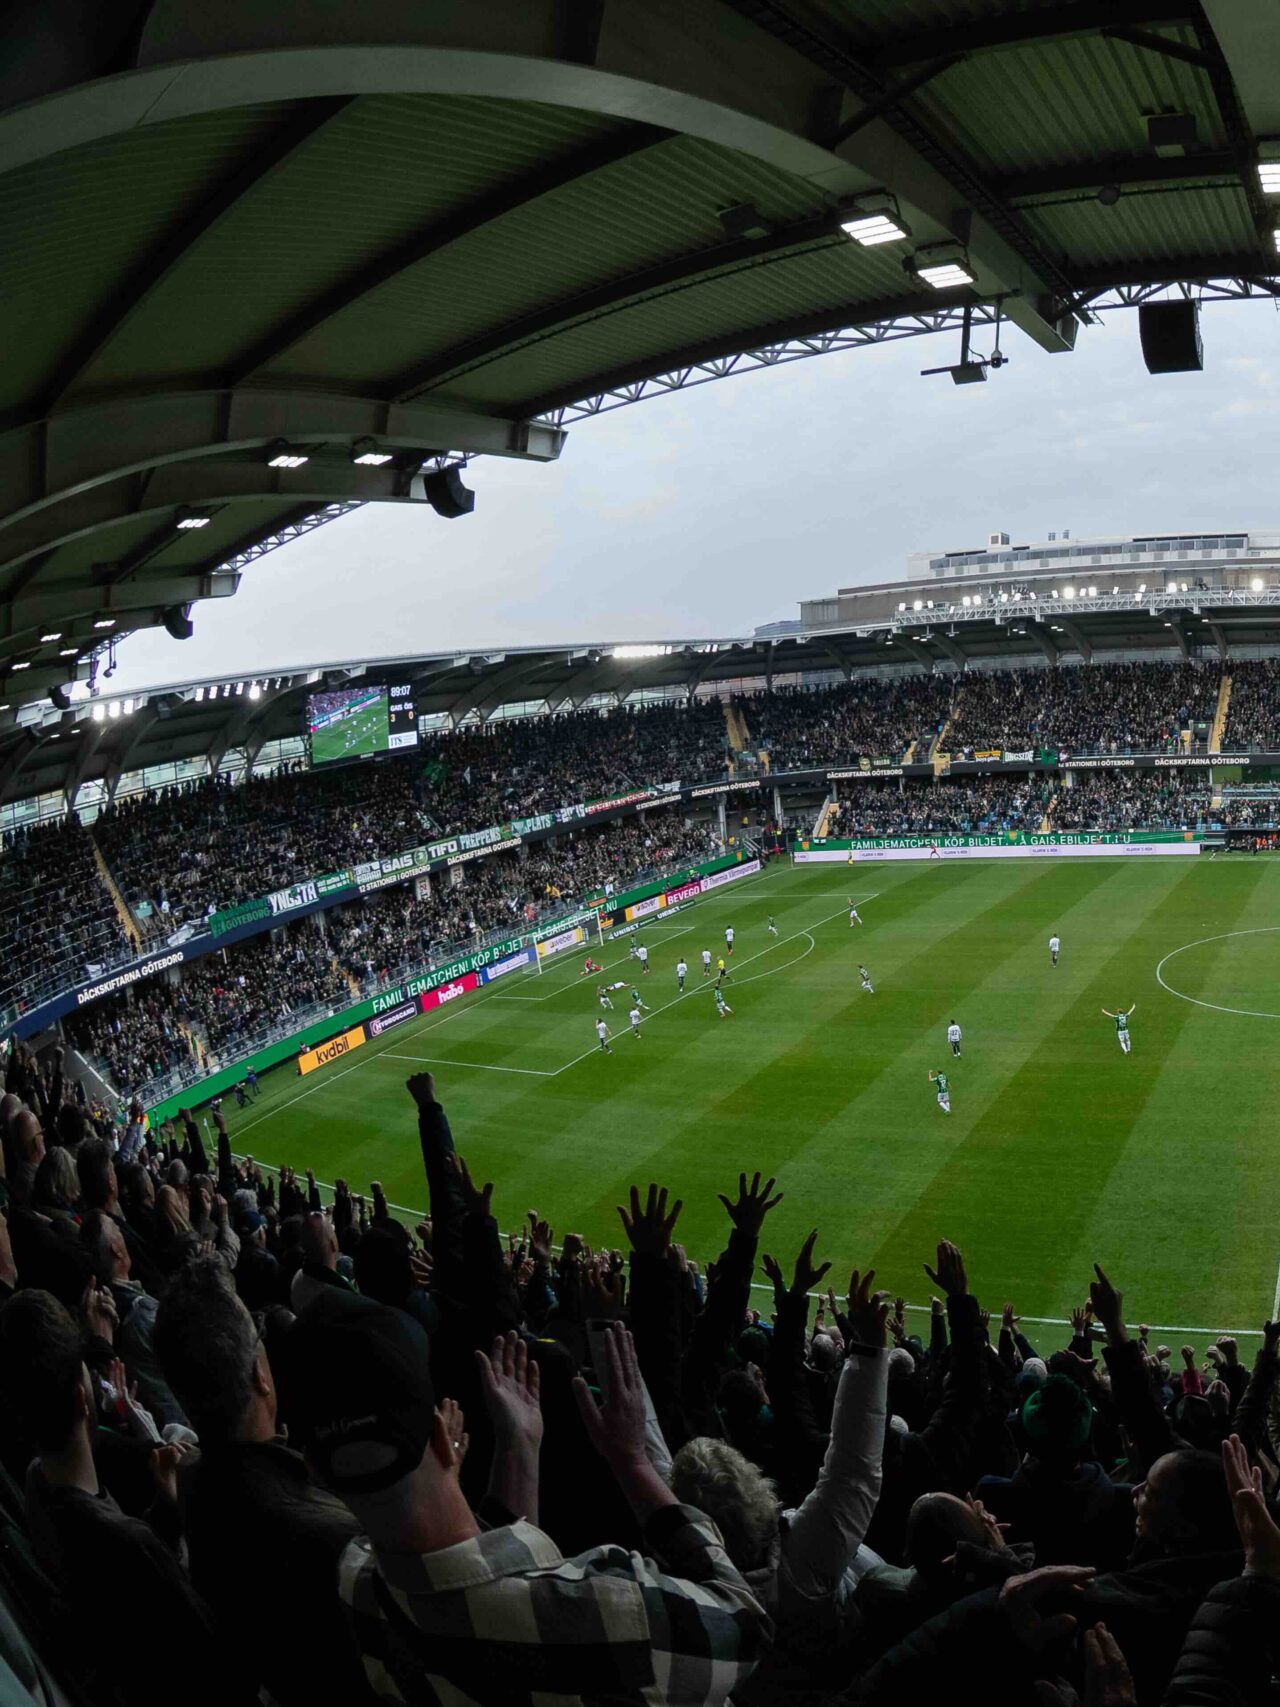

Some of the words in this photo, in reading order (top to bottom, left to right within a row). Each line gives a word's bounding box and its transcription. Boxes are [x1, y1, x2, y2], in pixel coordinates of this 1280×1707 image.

[391, 685, 411, 697] 89:07
[390, 713, 396, 722] 3
[408, 711, 414, 720] 0
[1155, 758, 1210, 766] DÄCKSKIFTARNA
[1211, 757, 1250, 765] GÖTEBORG
[827, 771, 871, 779] DÄCKSKIFTARNA
[730, 780, 760, 790] GÖTEBORG
[851, 838, 941, 850] FAMILJEMATCHEN!
[944, 836, 965, 847] KÖP
[969, 836, 1007, 846] BILJET
[381, 854, 413, 874] GAIS
[428, 840, 458, 858] TIFO
[359, 885, 366, 893] 12
[366, 875, 398, 891] STATIONER
[667, 885, 700, 905] BEVEGO
[657, 905, 680, 919] UNIBET
[613, 922, 640, 937] UNIBET
[472, 951, 490, 970] KÖP
[77, 970, 141, 1004] DÄCKSKIFTARNA
[141, 951, 184, 977] GÖTEBORG
[438, 982, 464, 1004] habo
[375, 1006, 415, 1031] HYDROSCAND
[316, 1036, 350, 1065] kvdbil
